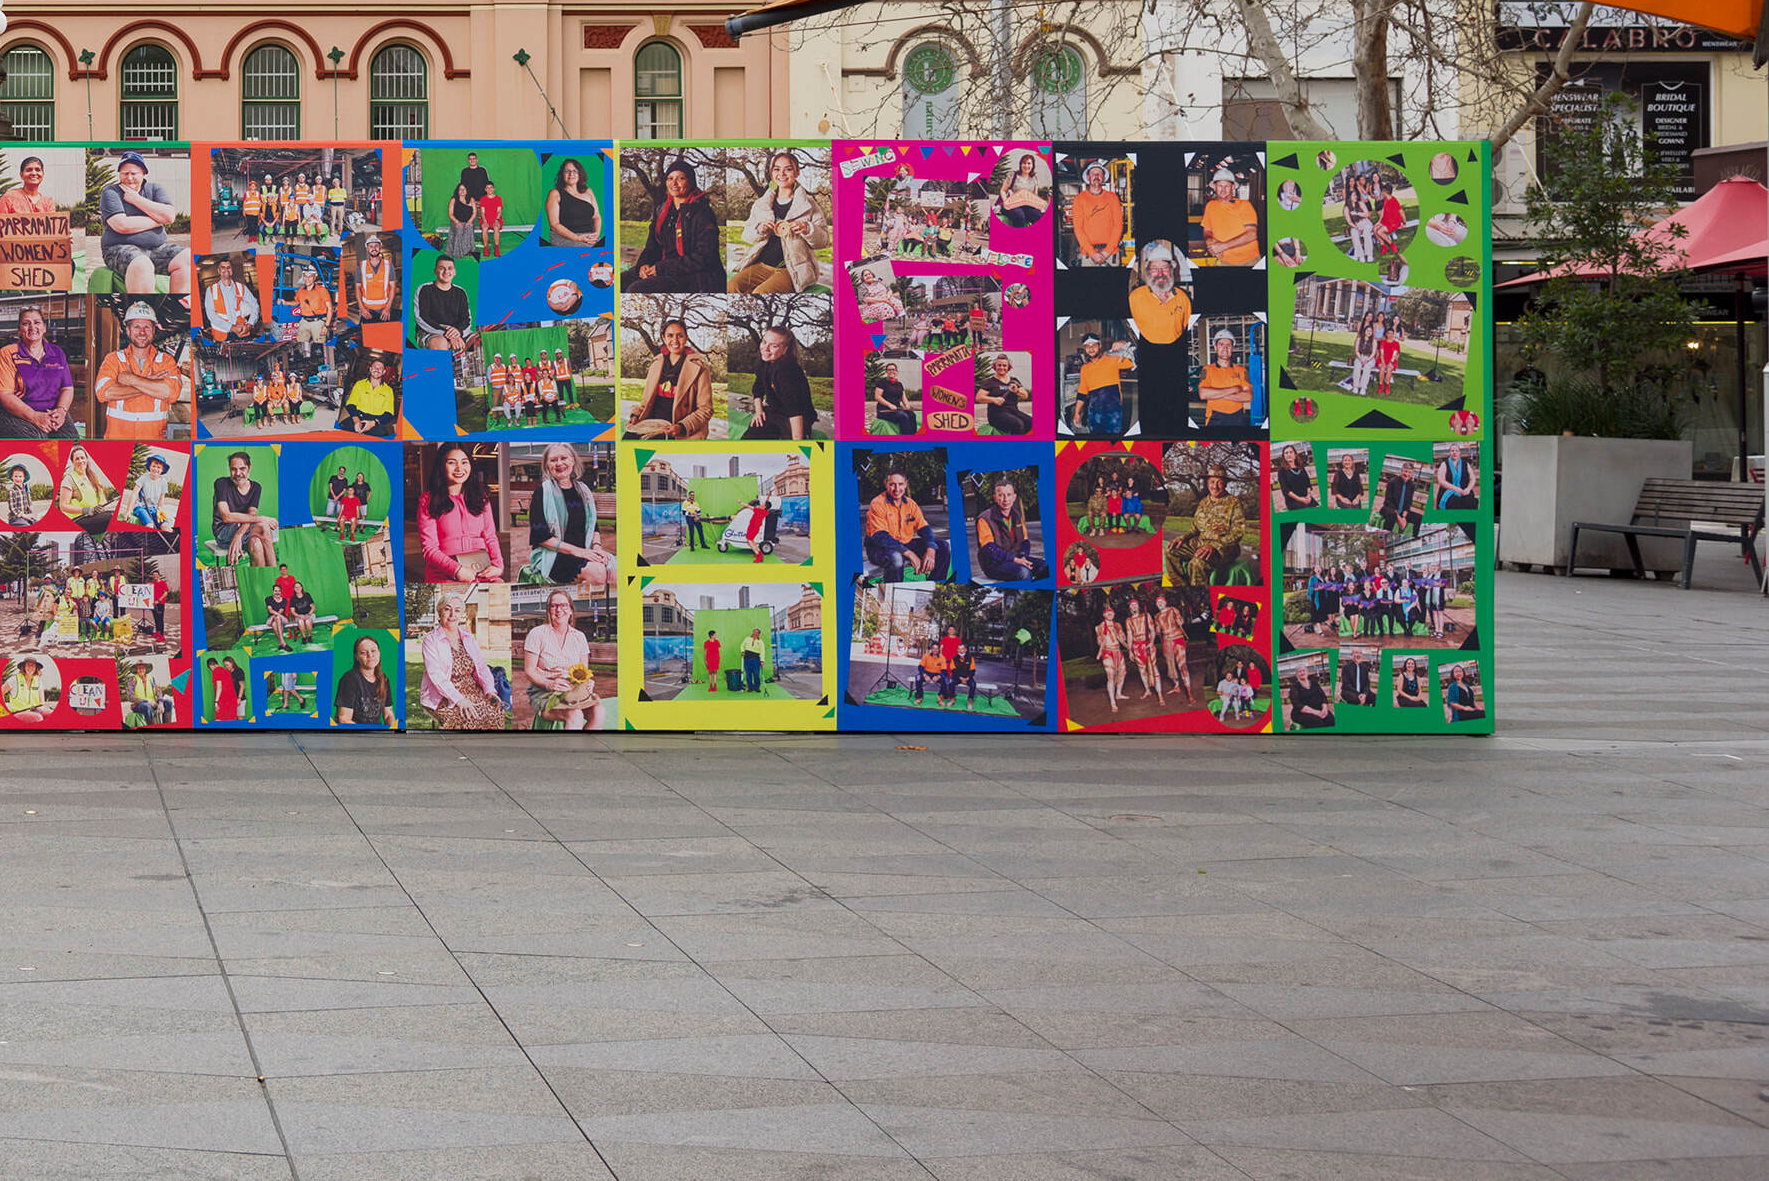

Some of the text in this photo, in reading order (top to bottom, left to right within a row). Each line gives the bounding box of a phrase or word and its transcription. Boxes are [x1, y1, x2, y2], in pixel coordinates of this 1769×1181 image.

[1655, 93, 1687, 101] BRIDAL
[1647, 104, 1697, 113] BOUTIQUE
[0, 242, 67, 262] WOMEN'S
[11, 268, 55, 287] SHED
[926, 346, 972, 376] PARRAMATTA
[932, 387, 966, 409] WOMEN'S
[933, 413, 970, 429] SHED
